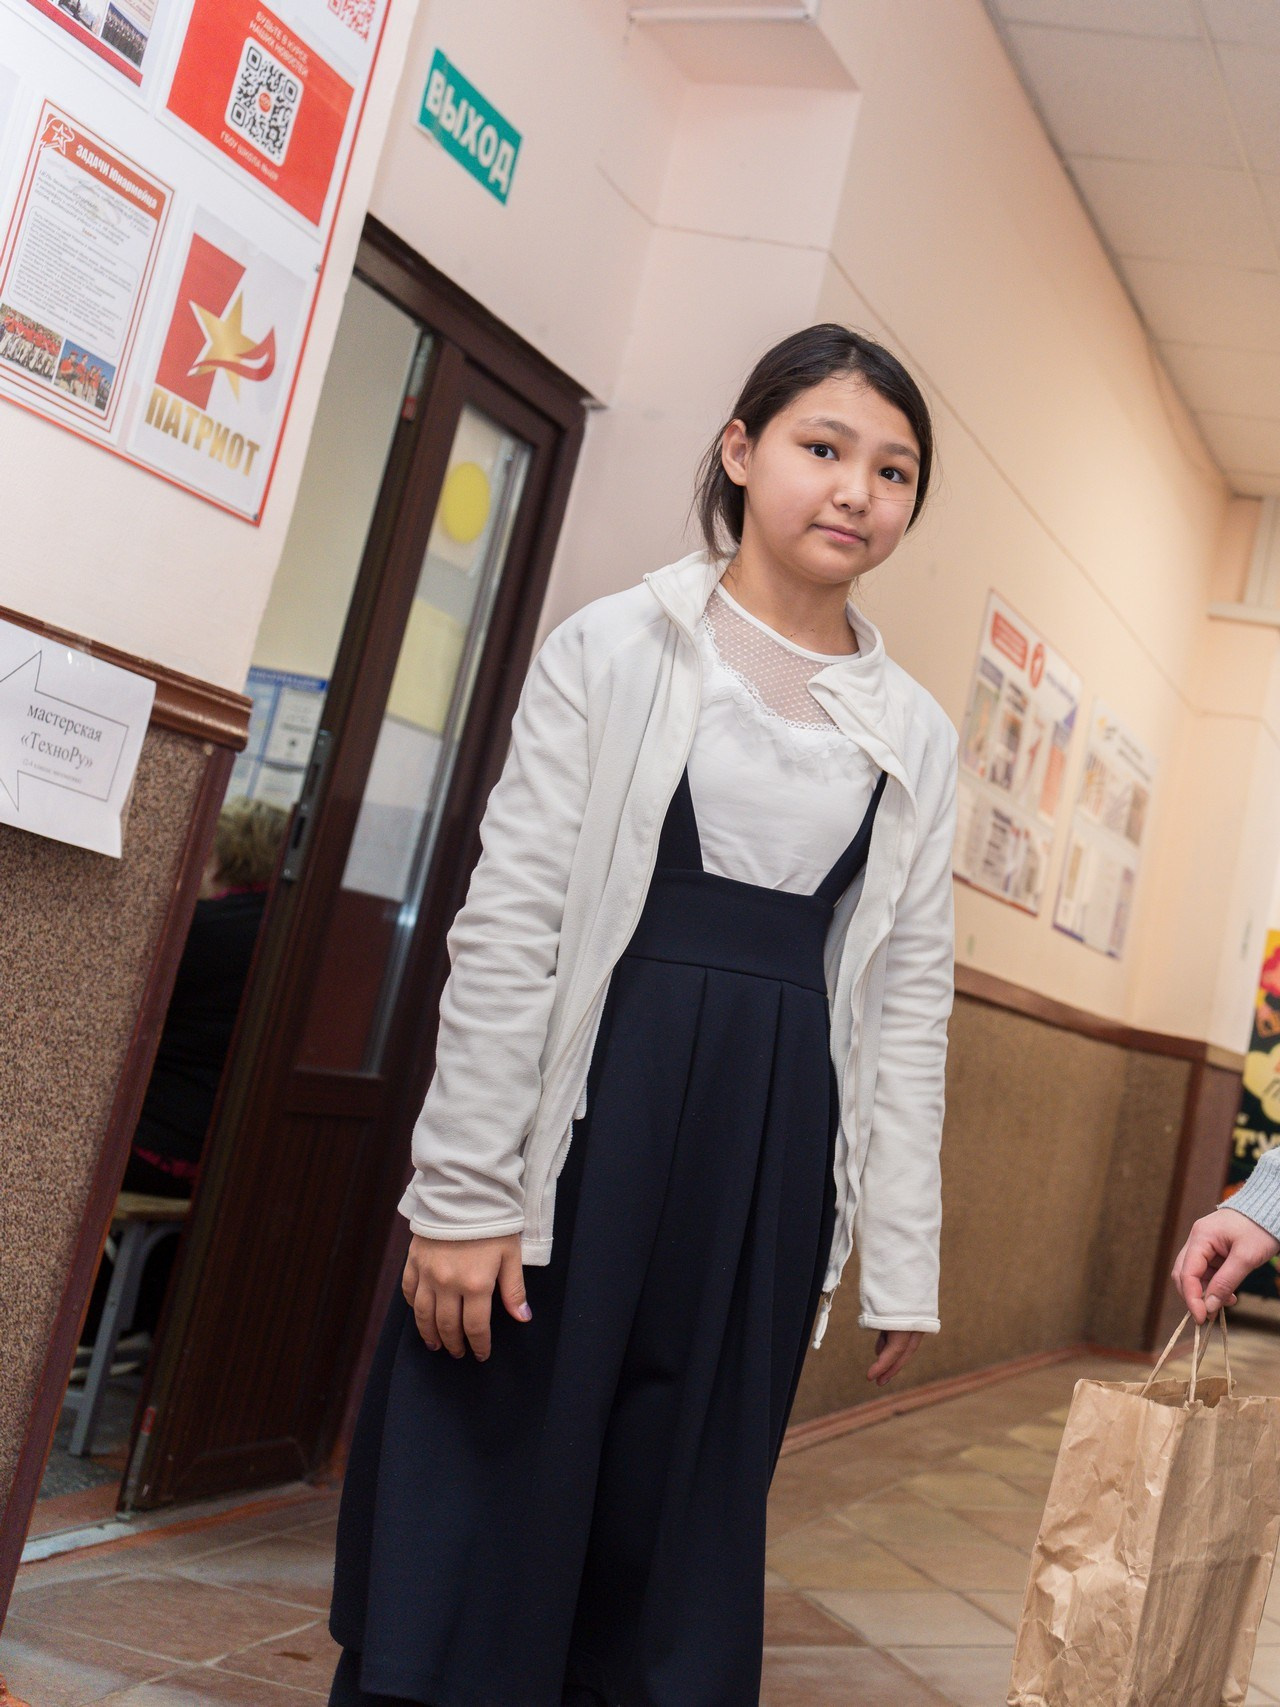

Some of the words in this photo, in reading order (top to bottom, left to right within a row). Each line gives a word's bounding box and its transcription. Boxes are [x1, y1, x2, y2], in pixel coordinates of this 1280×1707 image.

[425, 68, 515, 195] ВЫХОД
[75, 144, 110, 177] ЗАДАЧИ
[144, 386, 261, 478] ПАТРИОТ
[27, 705, 102, 742] мастерская
[20, 732, 93, 769] «ТехноРу»
